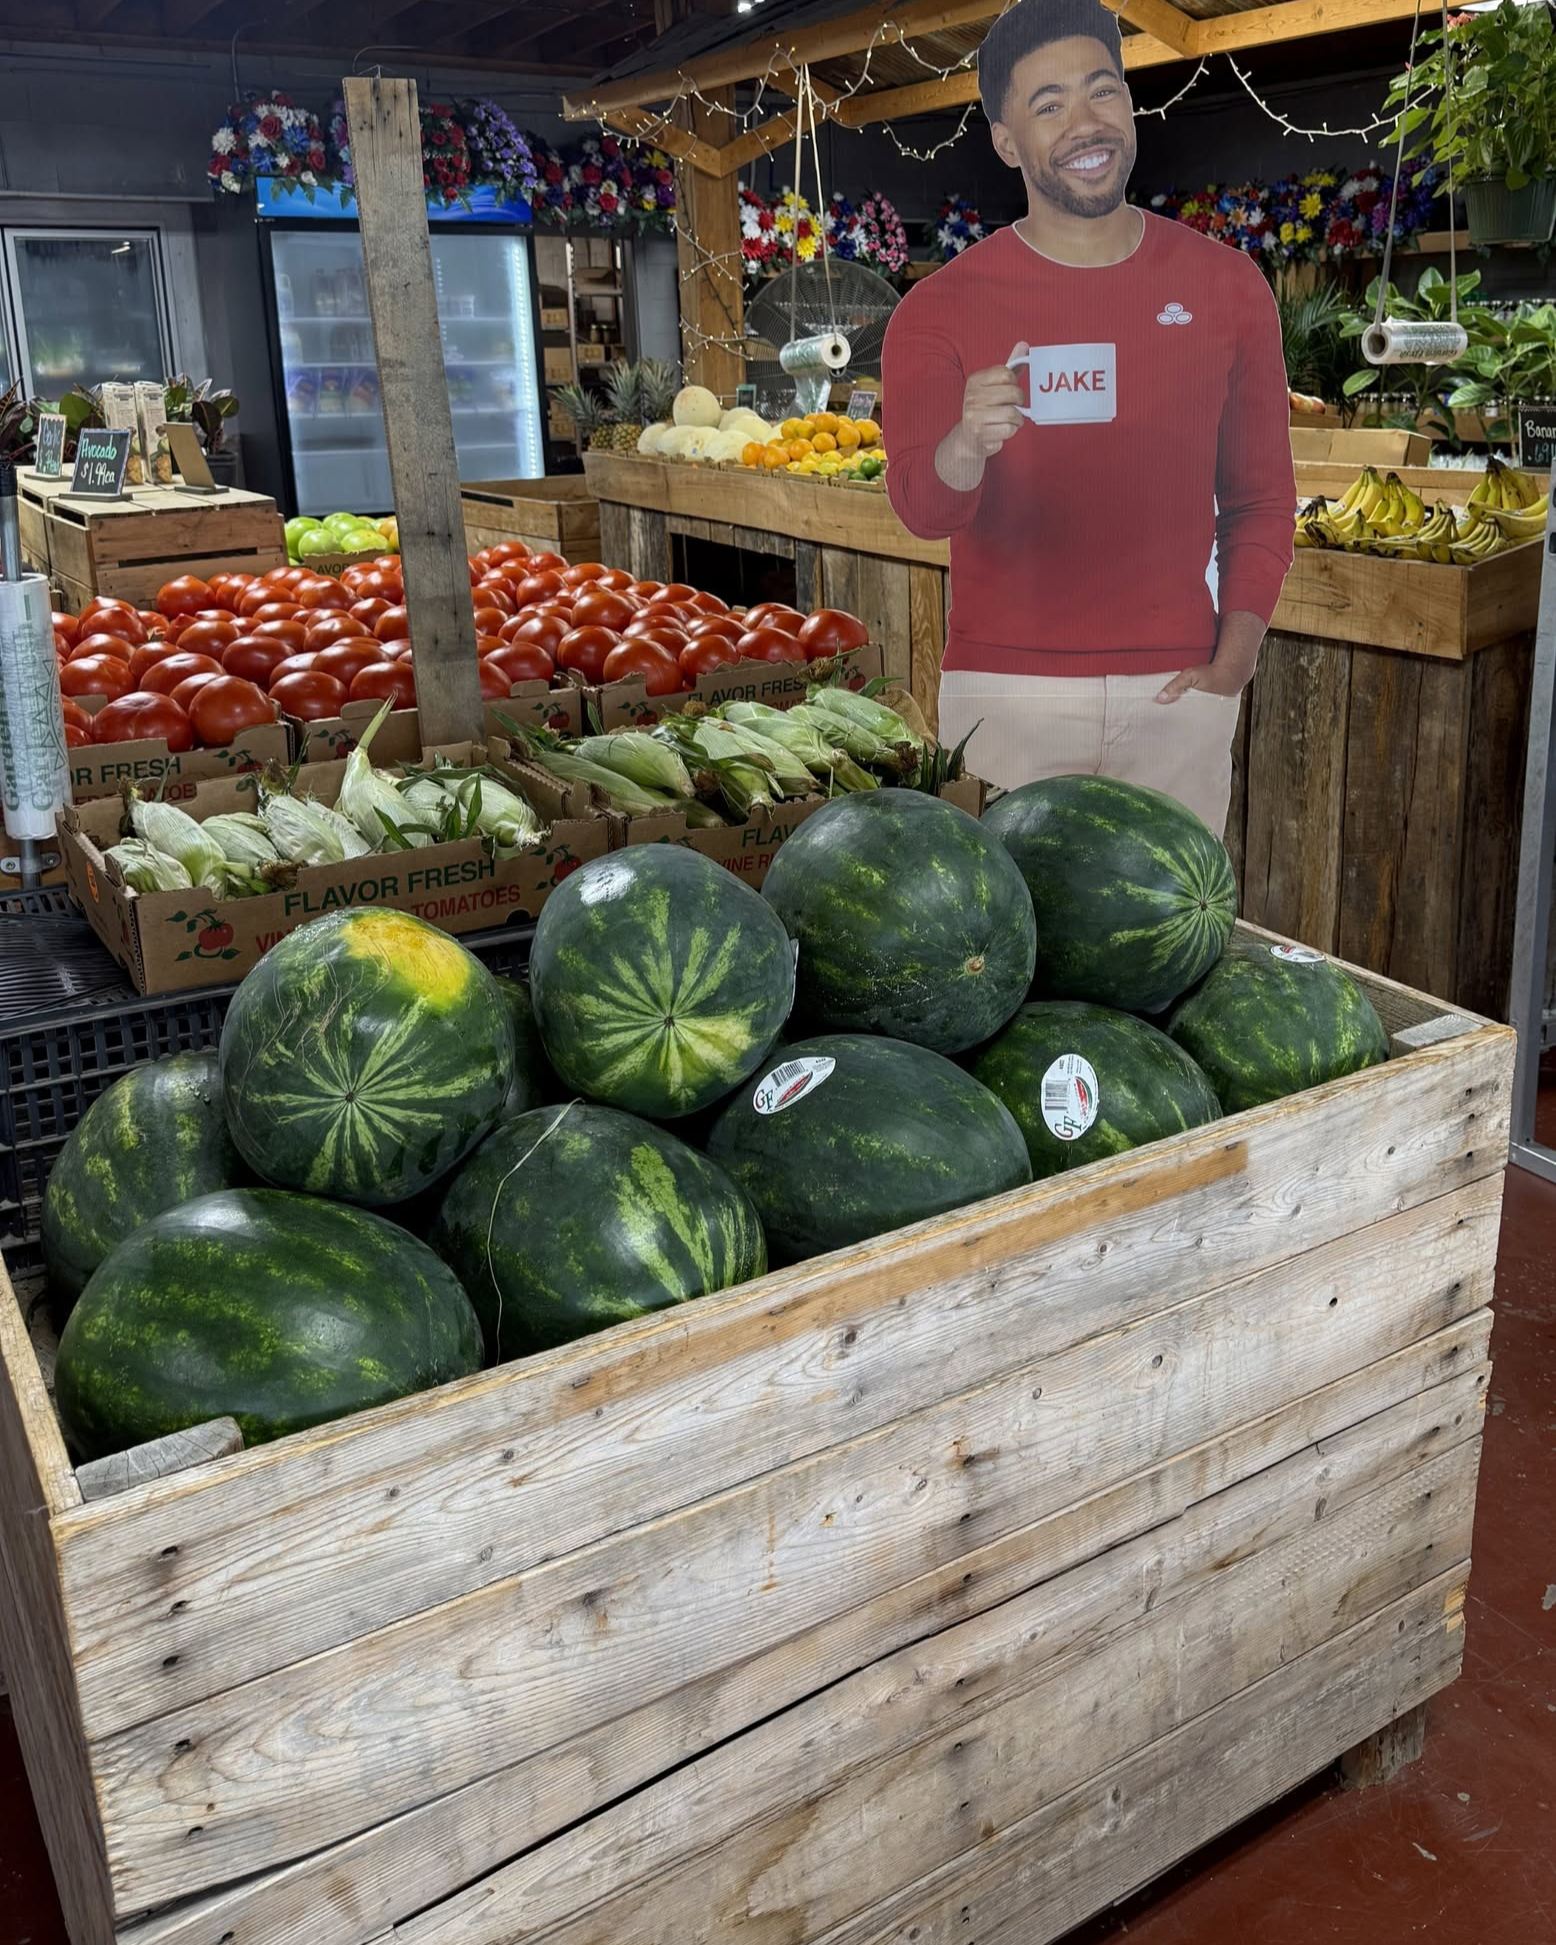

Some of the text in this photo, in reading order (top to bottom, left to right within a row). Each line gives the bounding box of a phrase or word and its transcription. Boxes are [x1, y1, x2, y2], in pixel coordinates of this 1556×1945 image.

[1039, 370, 1106, 393] JAKE
[81, 434, 117, 460] Avocado
[762, 677, 806, 697] FRES
[101, 756, 181, 784] FRESH
[284, 859, 495, 917] FLAVOR FRESH
[411, 883, 521, 920] TOMATOES
